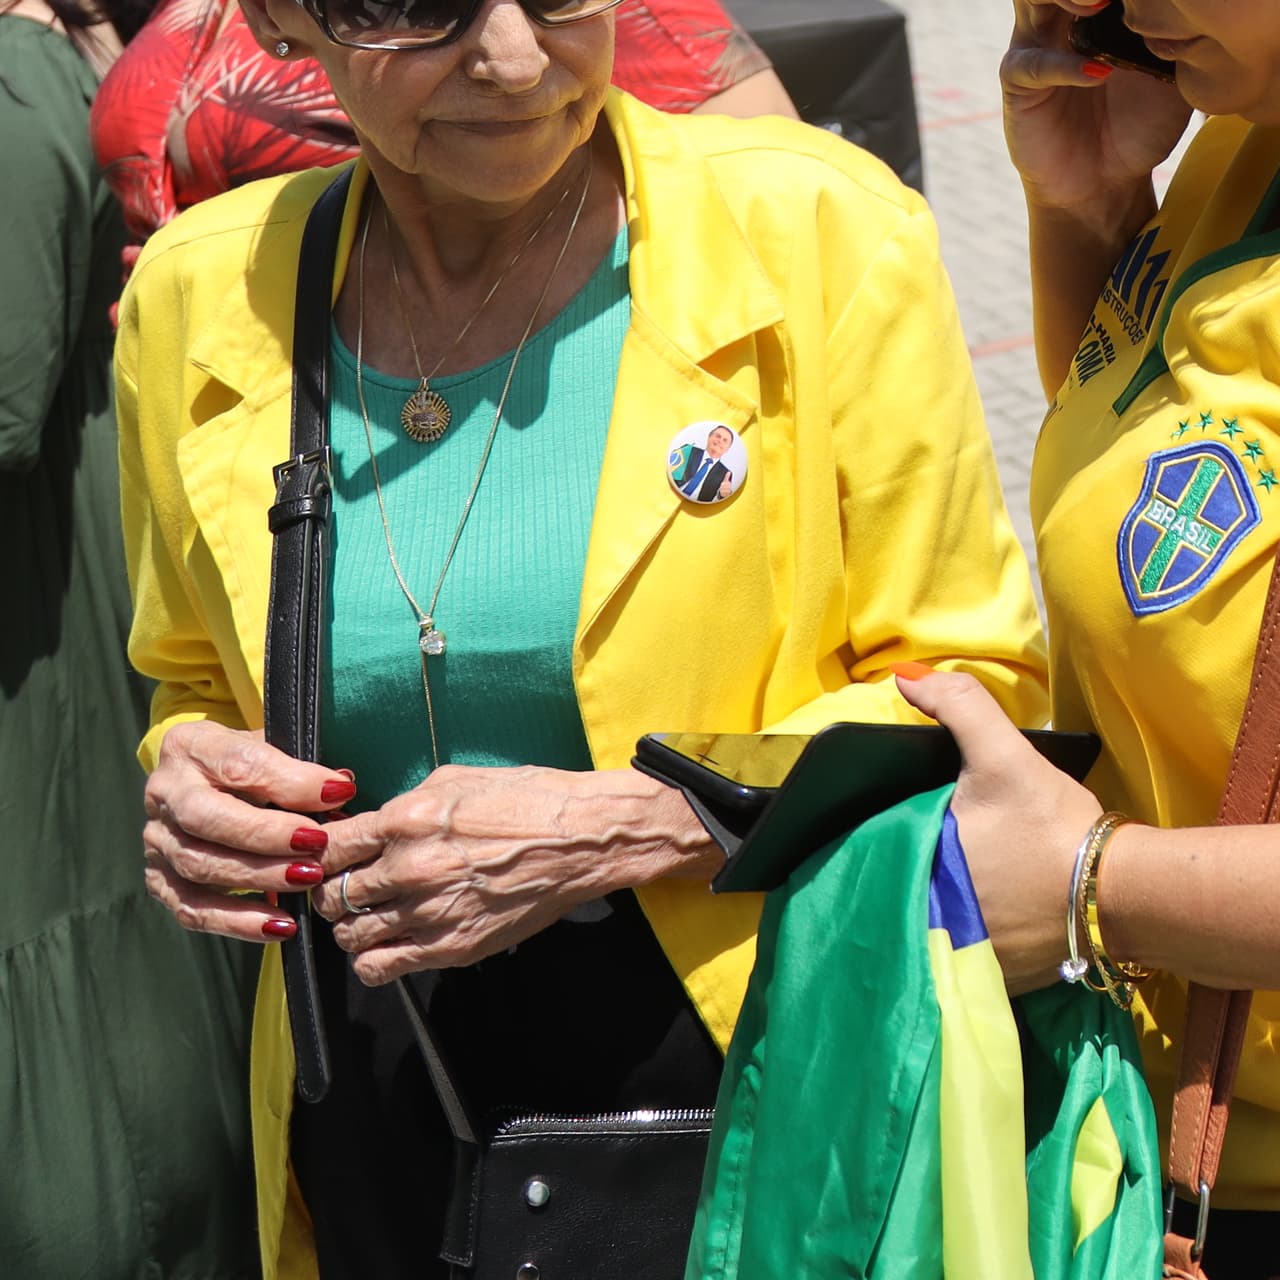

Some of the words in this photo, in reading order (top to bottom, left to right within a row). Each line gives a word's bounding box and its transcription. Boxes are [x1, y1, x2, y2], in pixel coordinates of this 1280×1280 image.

[1075, 329, 1105, 388] OMA
[1089, 314, 1117, 366] LHARIA
[1145, 498, 1211, 553] BRASIL
